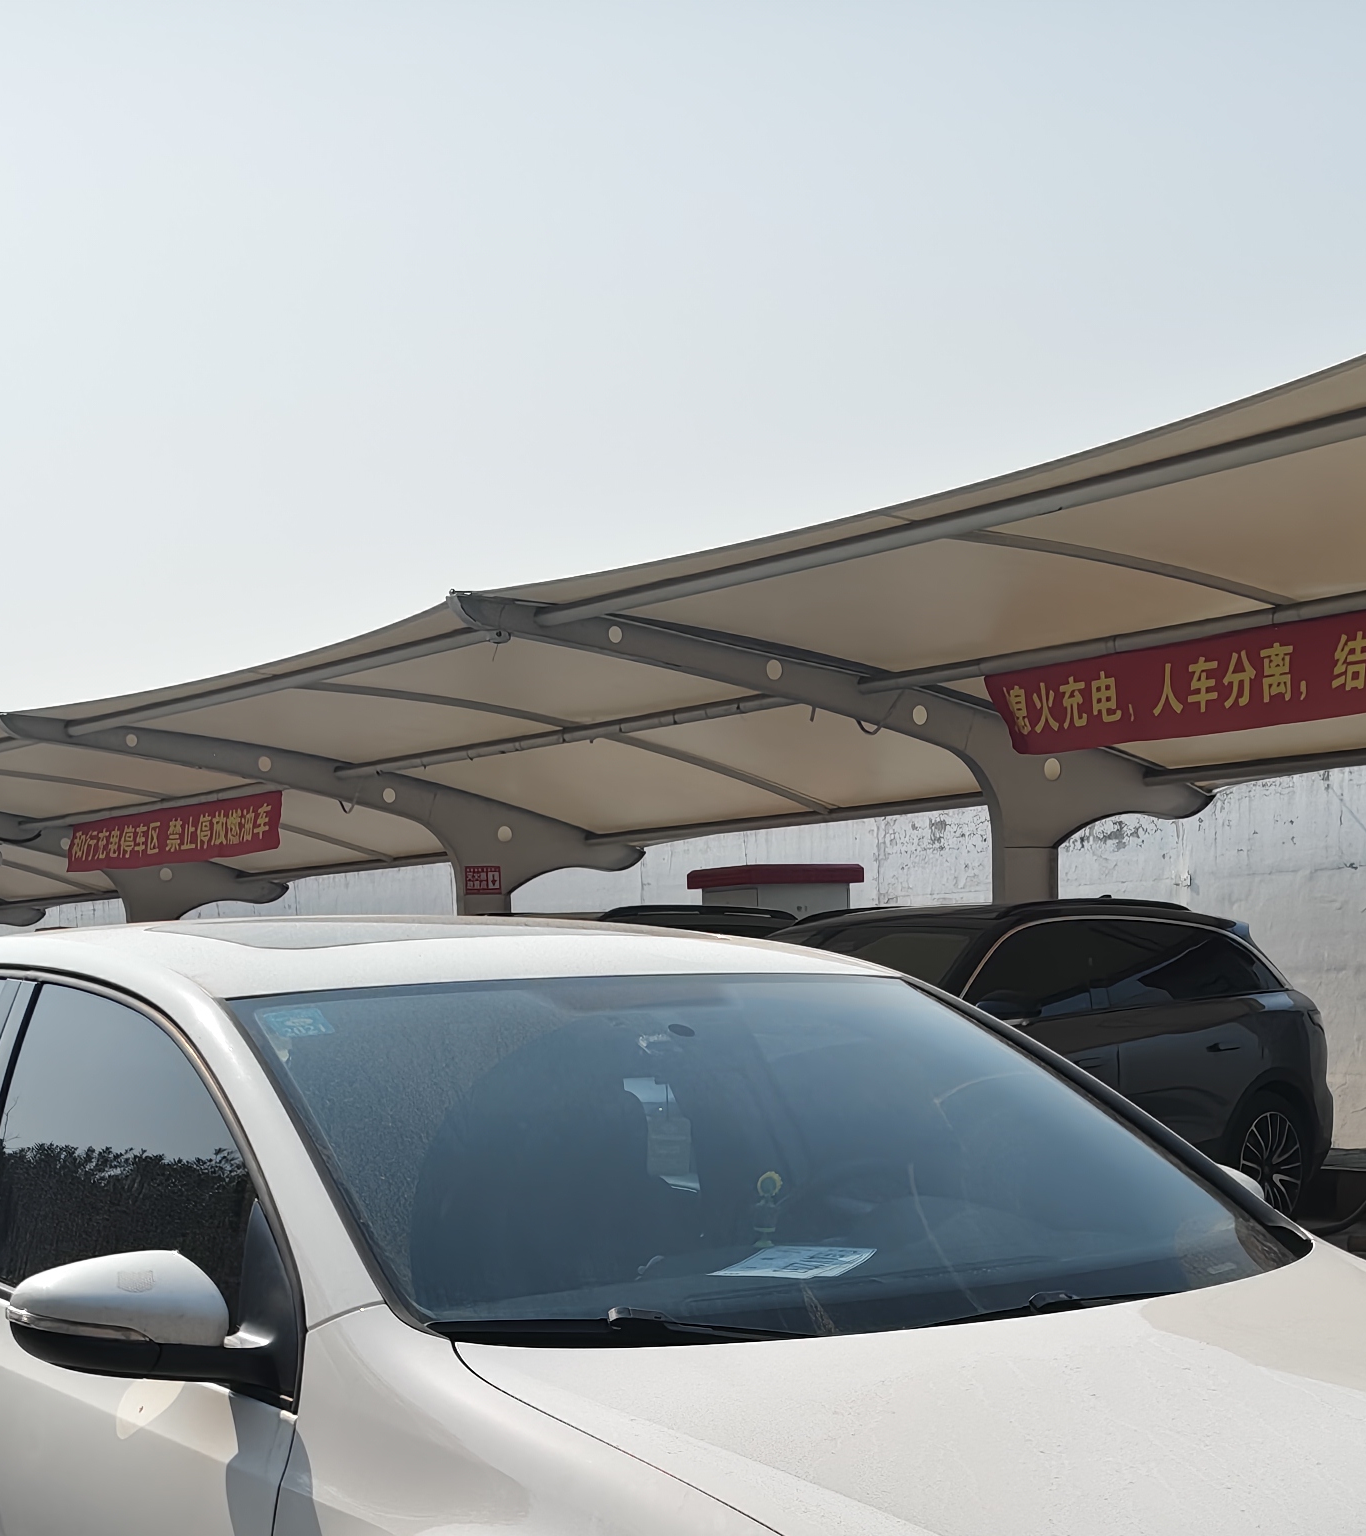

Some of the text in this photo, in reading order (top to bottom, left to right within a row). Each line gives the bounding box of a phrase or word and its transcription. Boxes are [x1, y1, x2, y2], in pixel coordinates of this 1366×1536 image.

[72, 803, 271, 861] 和行充电停车区 禁止停放燃油车
